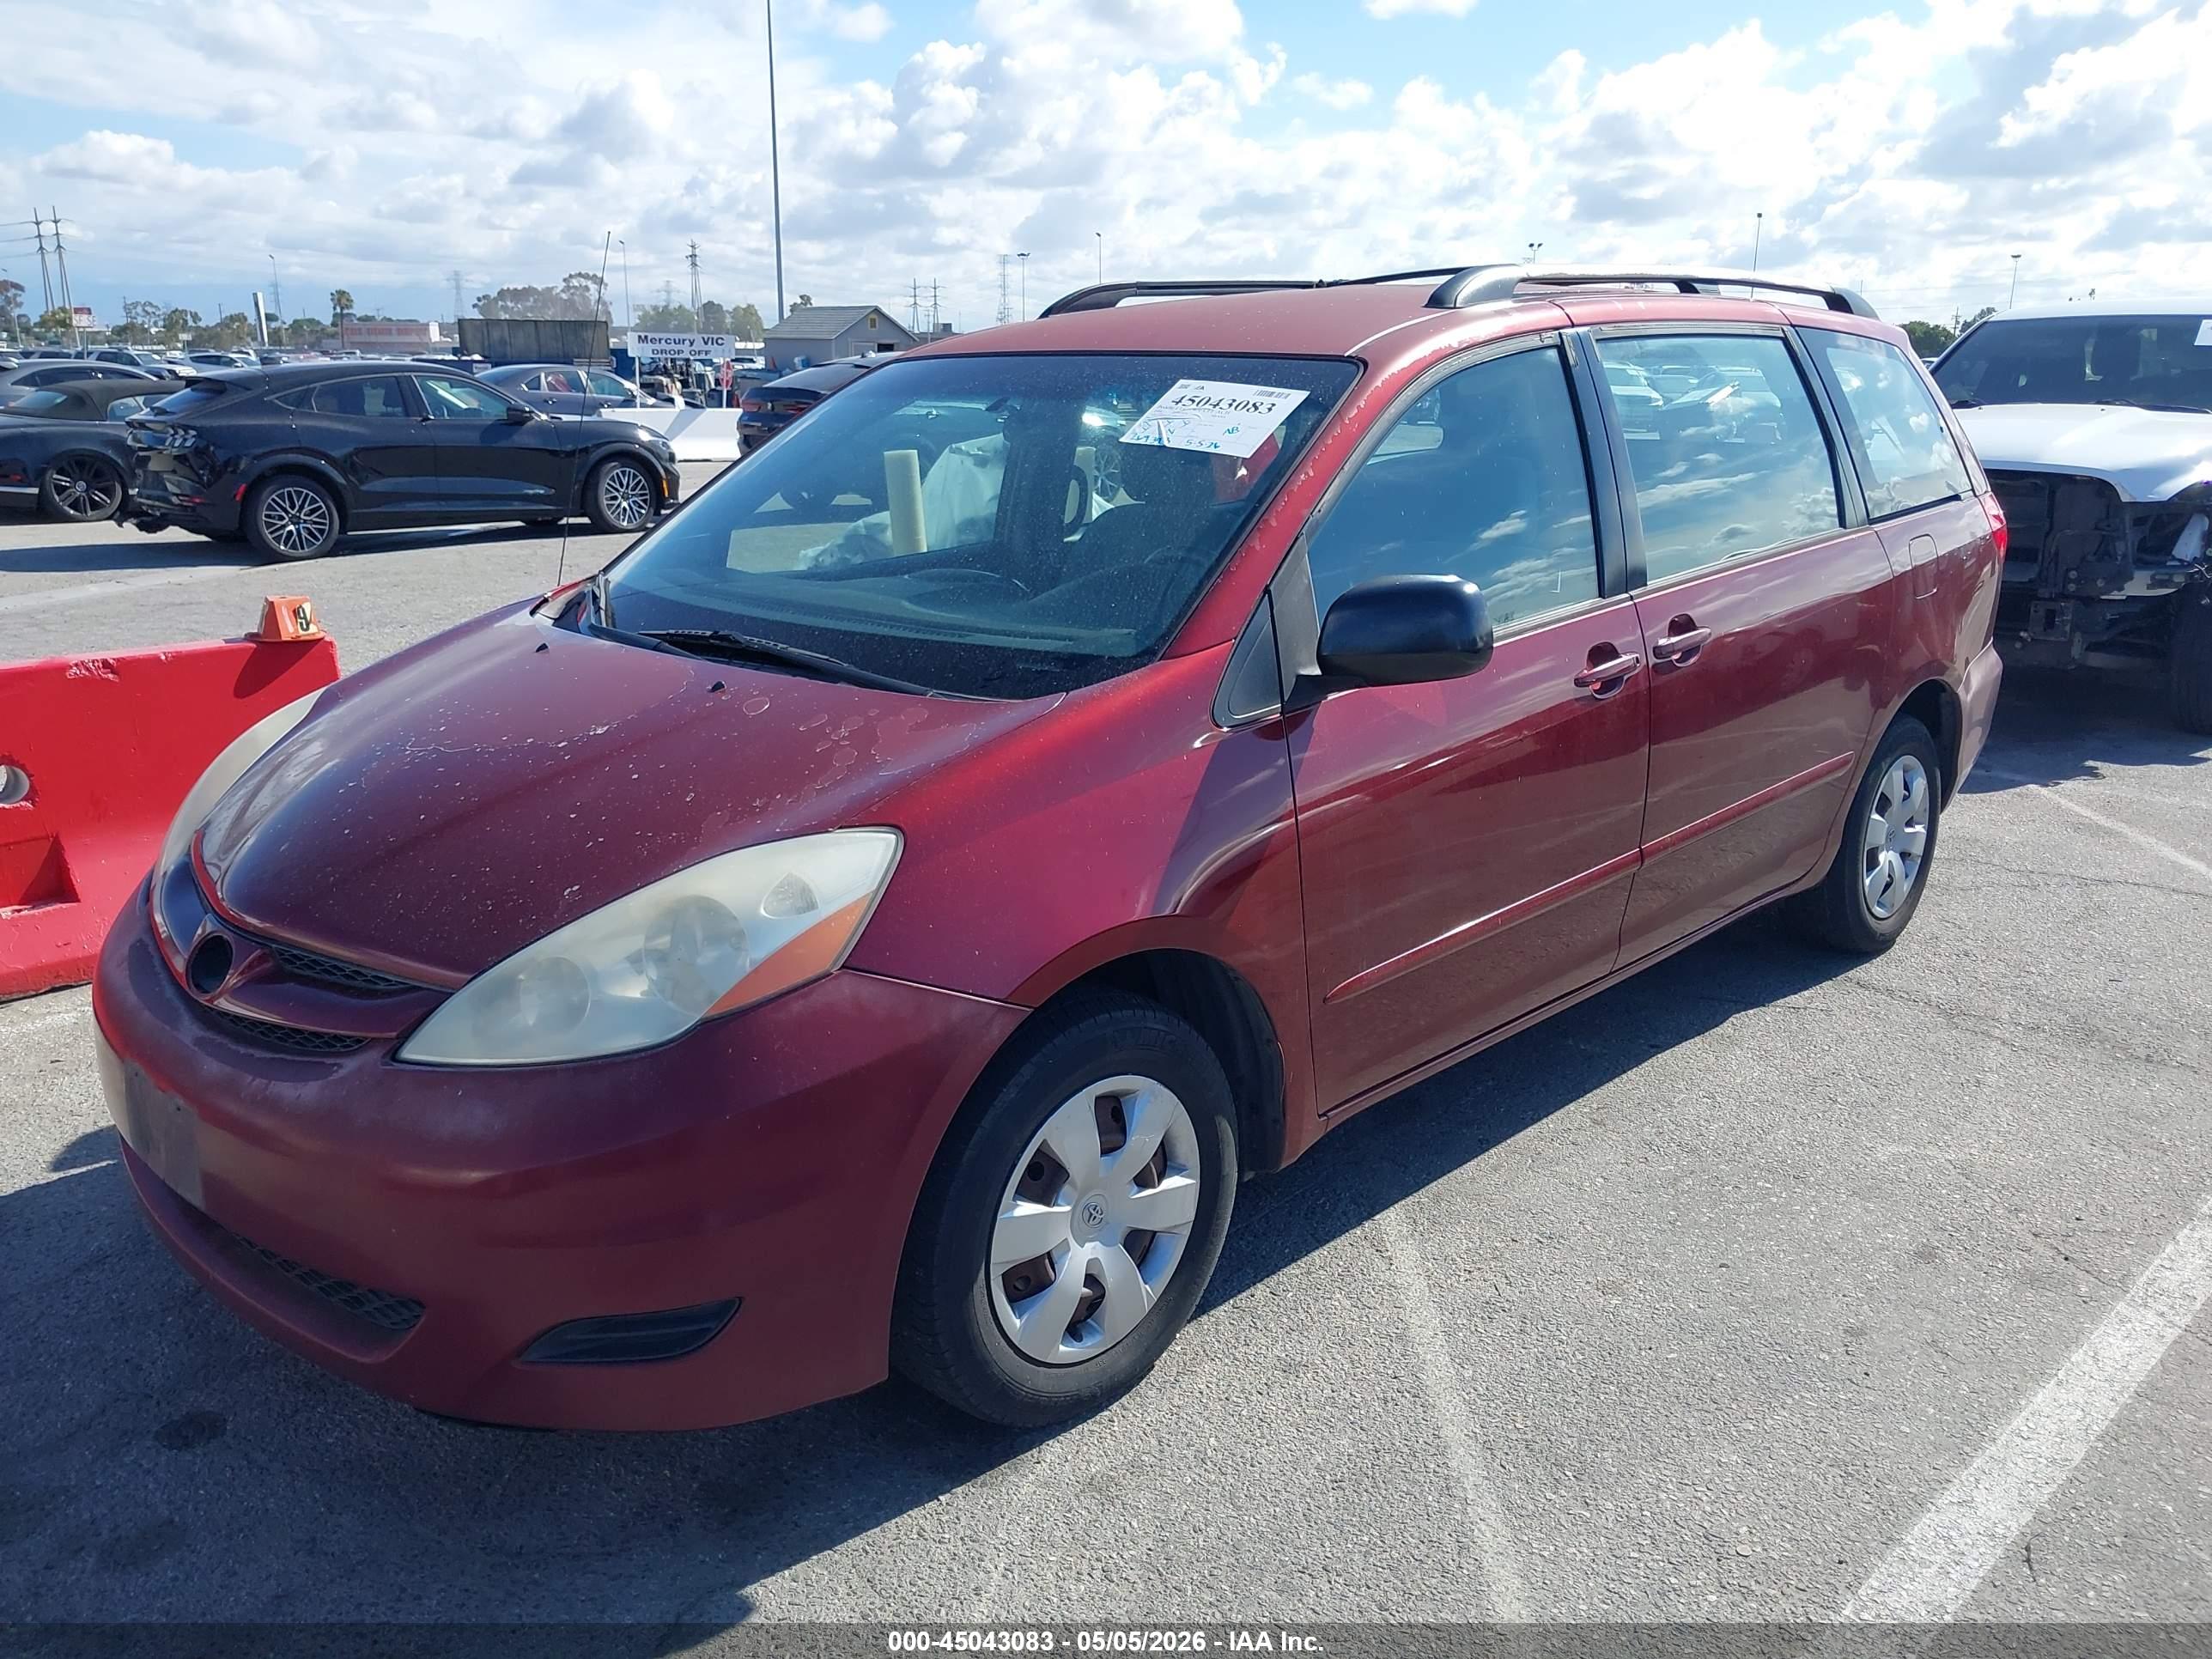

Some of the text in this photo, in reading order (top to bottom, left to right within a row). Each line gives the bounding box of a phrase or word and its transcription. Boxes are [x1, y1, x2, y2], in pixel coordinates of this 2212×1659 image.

[638, 334, 725, 348] Mercury VIC
[652, 348, 712, 357] DROP OFF
[1171, 394, 1277, 415] 45043083
